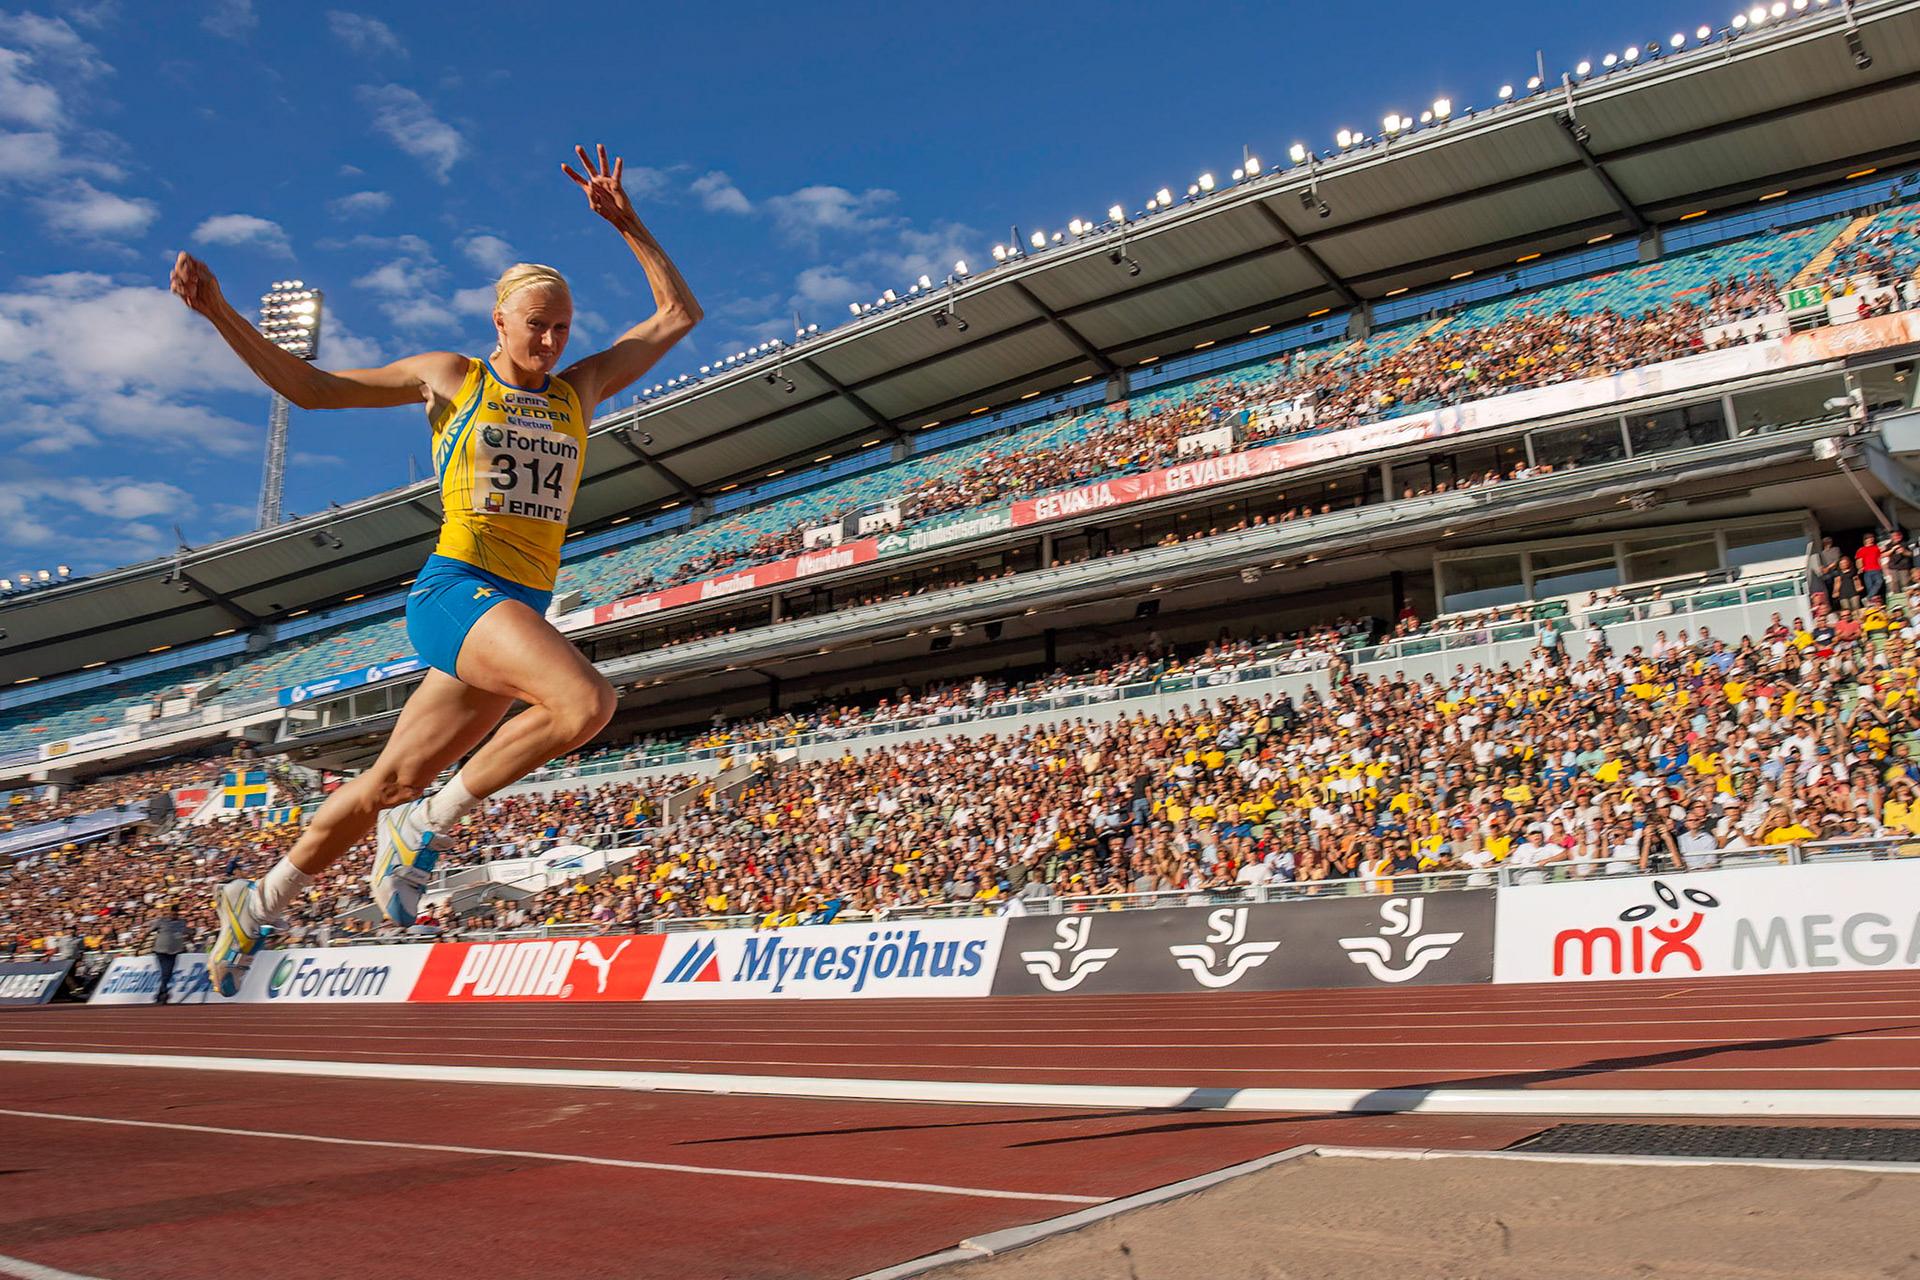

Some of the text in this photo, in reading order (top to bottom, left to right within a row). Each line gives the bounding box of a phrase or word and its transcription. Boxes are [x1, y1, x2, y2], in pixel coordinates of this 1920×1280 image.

[487, 401, 571, 423] SWEDEN
[517, 418, 552, 430] Fortum
[507, 429, 578, 460] Fortum
[490, 454, 564, 500] 314
[1166, 452, 1250, 492] GEVALIA
[1035, 484, 1114, 520] GEVALIA
[1053, 916, 1093, 952] SJ
[1206, 907, 1249, 945] SJ
[1380, 897, 1425, 937] SJ
[733, 929, 987, 993] Myresjöhus
[1553, 911, 1706, 977] mix
[285, 957, 392, 996] Fortum
[448, 940, 580, 997] PUMA
